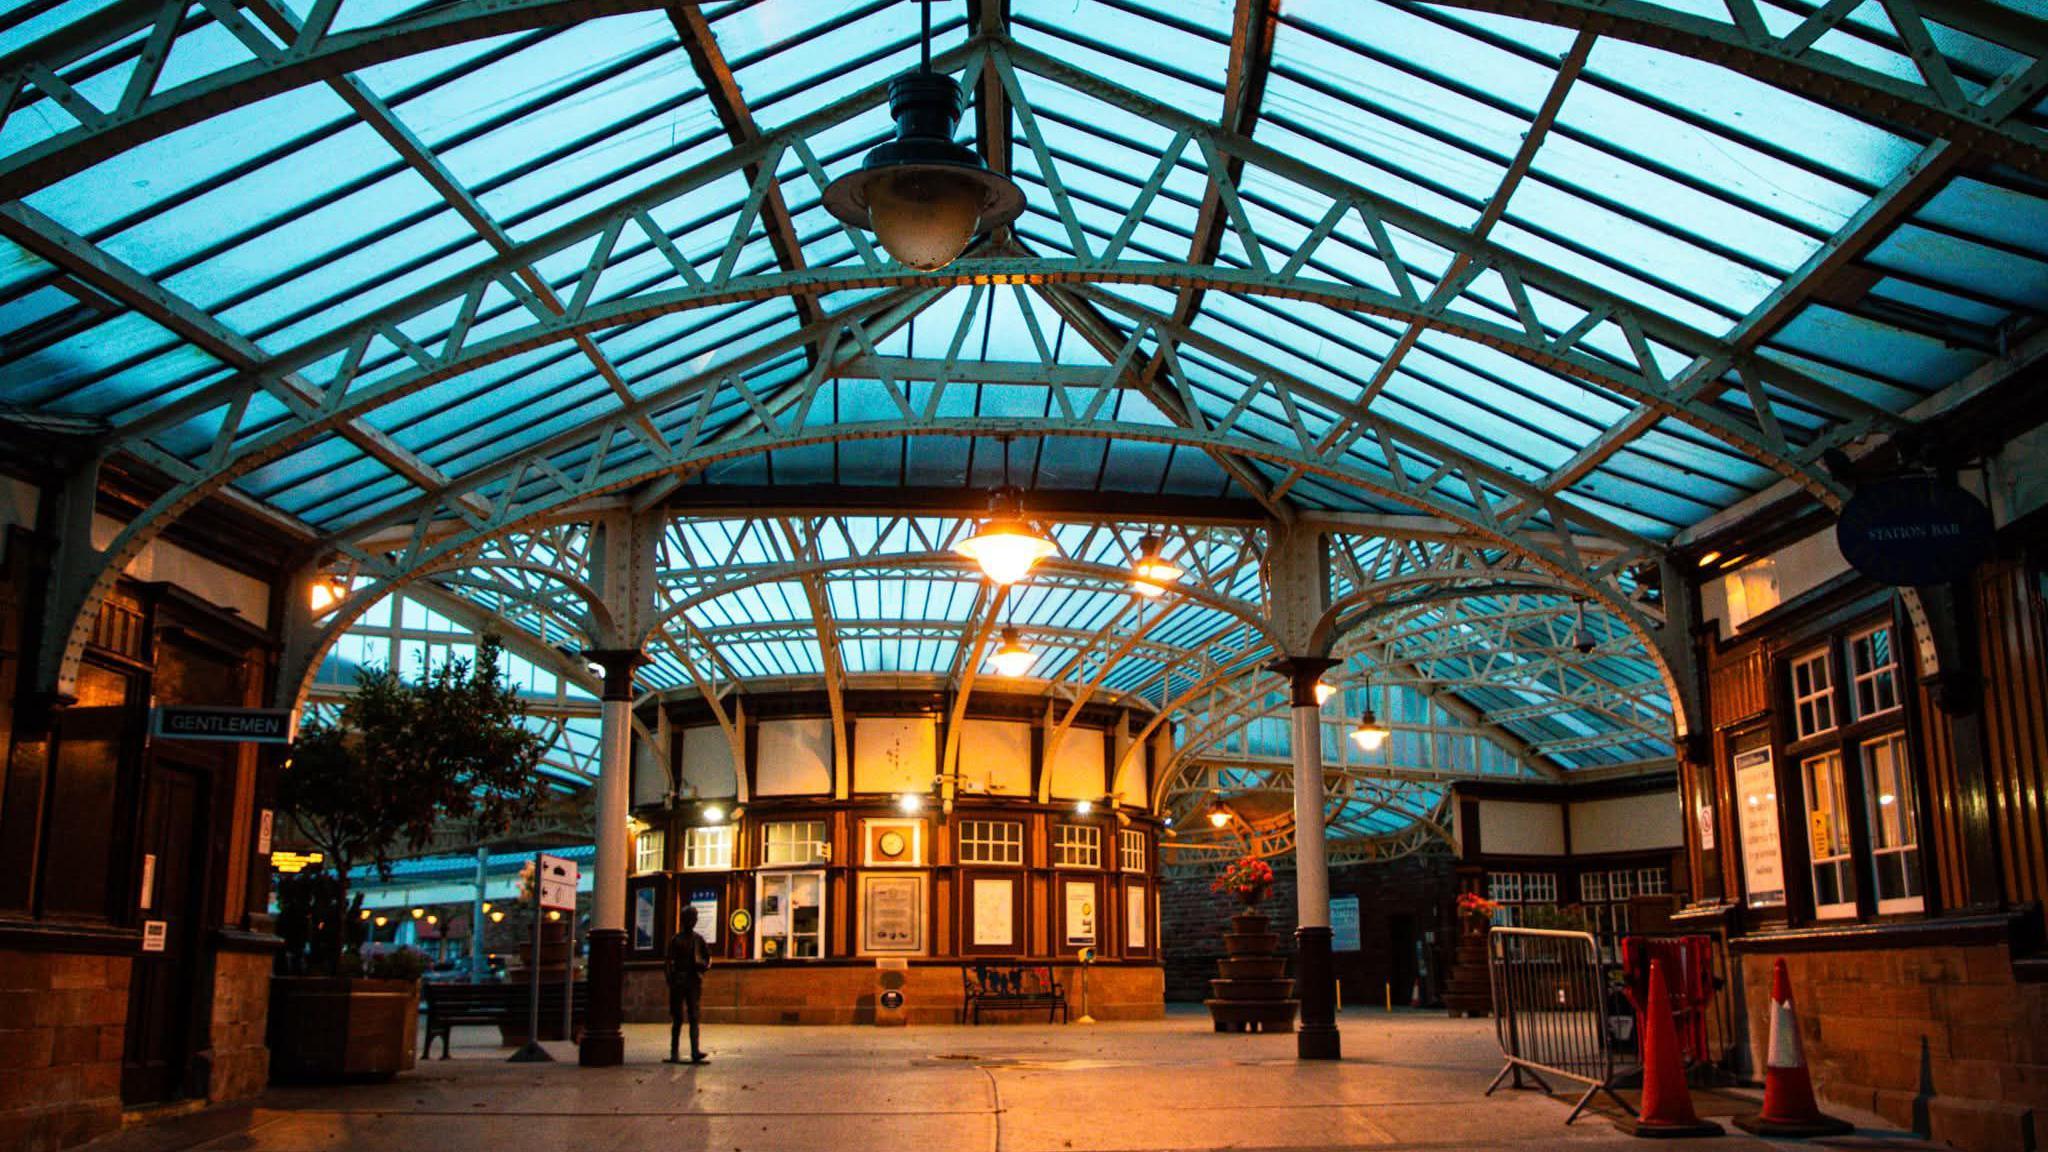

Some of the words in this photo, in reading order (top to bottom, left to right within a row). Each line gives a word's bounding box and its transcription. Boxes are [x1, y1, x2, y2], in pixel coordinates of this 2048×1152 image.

[1869, 524, 1927, 540] STATION
[1932, 524, 1960, 536] BAR
[171, 715, 279, 733] GENTLEMEN
